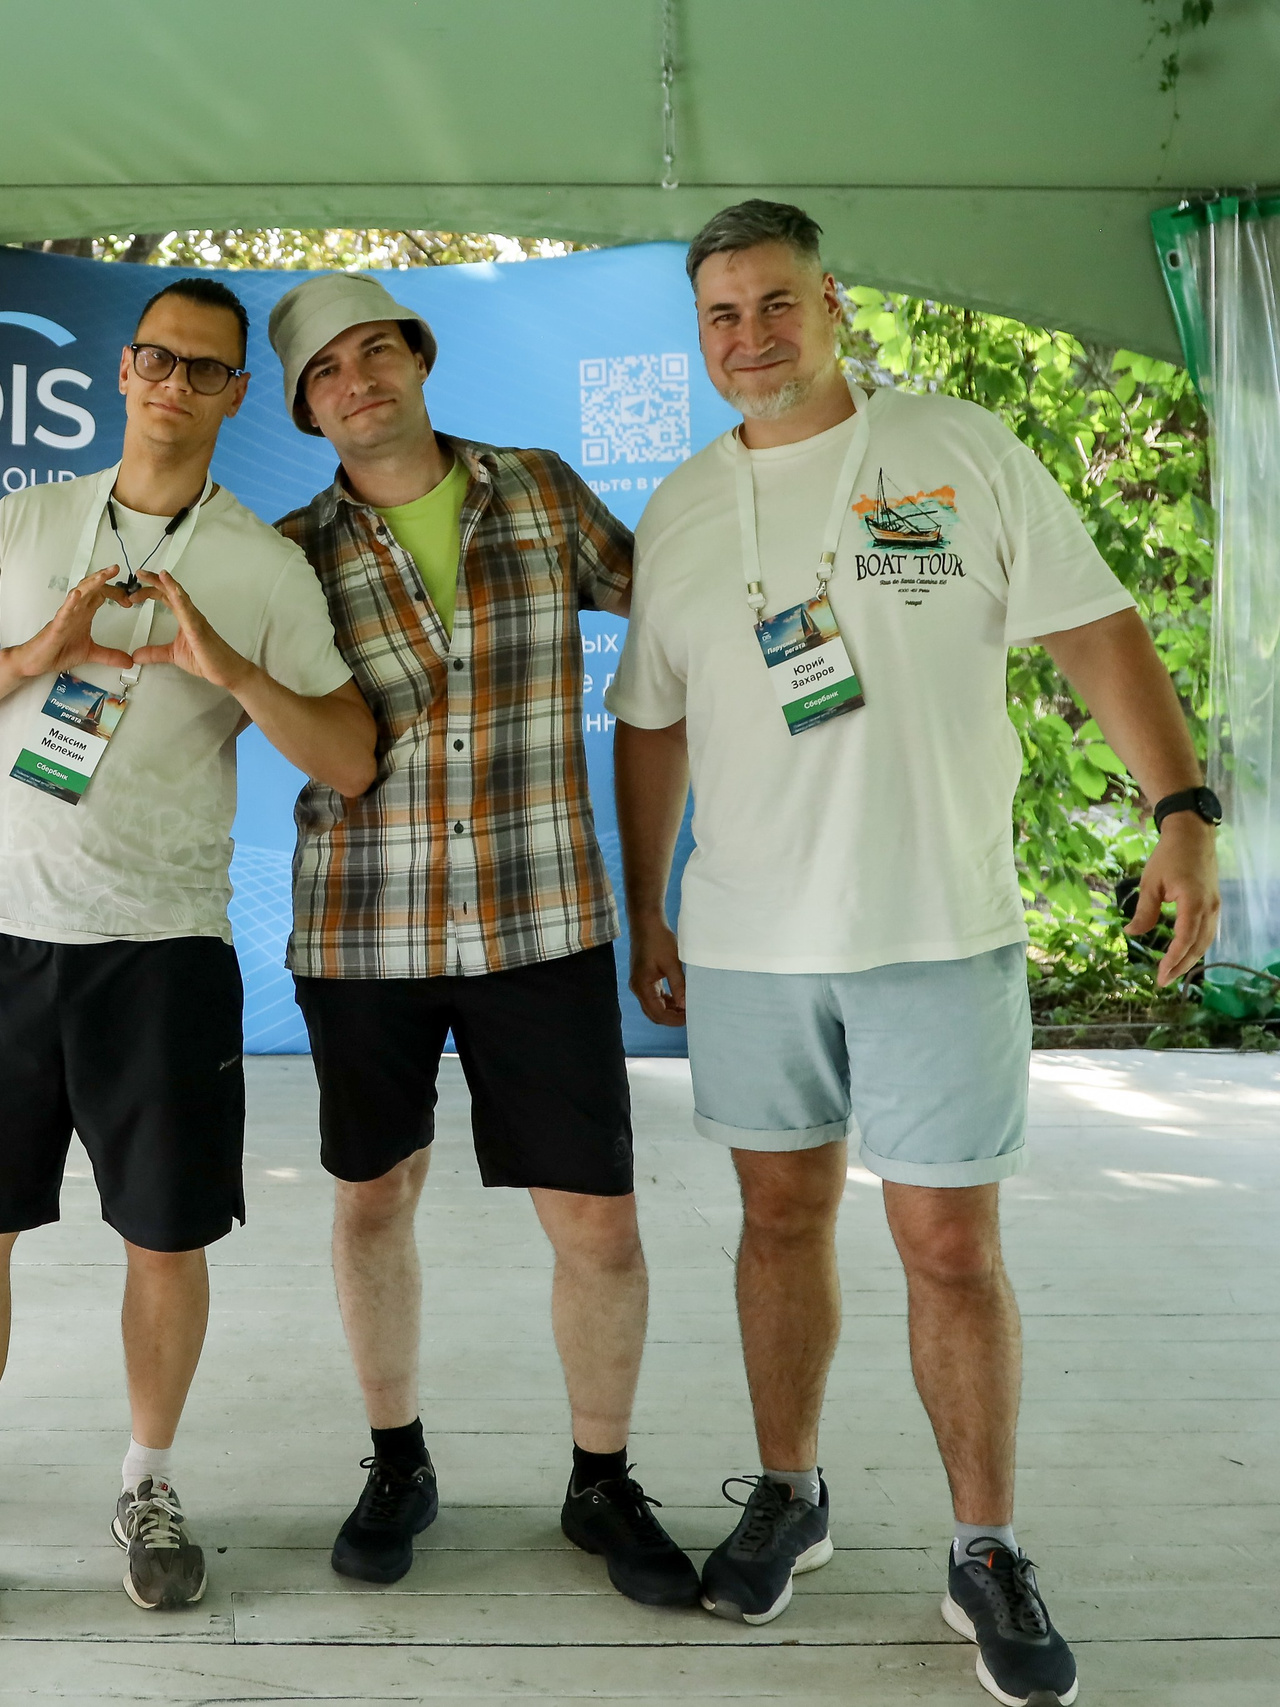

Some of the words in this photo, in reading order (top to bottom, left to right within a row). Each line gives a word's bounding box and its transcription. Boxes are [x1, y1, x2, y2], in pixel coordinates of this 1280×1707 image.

[588, 478, 632, 495] дьте
[855, 553, 907, 581] BOAT
[913, 553, 966, 578] TOUR
[582, 634, 619, 653] ых
[784, 642, 806, 656] регата
[793, 656, 825, 676] Юрий
[791, 666, 835, 689] Захаров
[50, 698, 80, 715] Парусная
[804, 691, 839, 709] Сбербанк
[61, 711, 82, 724] регата
[48, 728, 87, 751] Максим
[41, 737, 85, 762] Мелехин
[36, 761, 68, 781] Сбербанк
